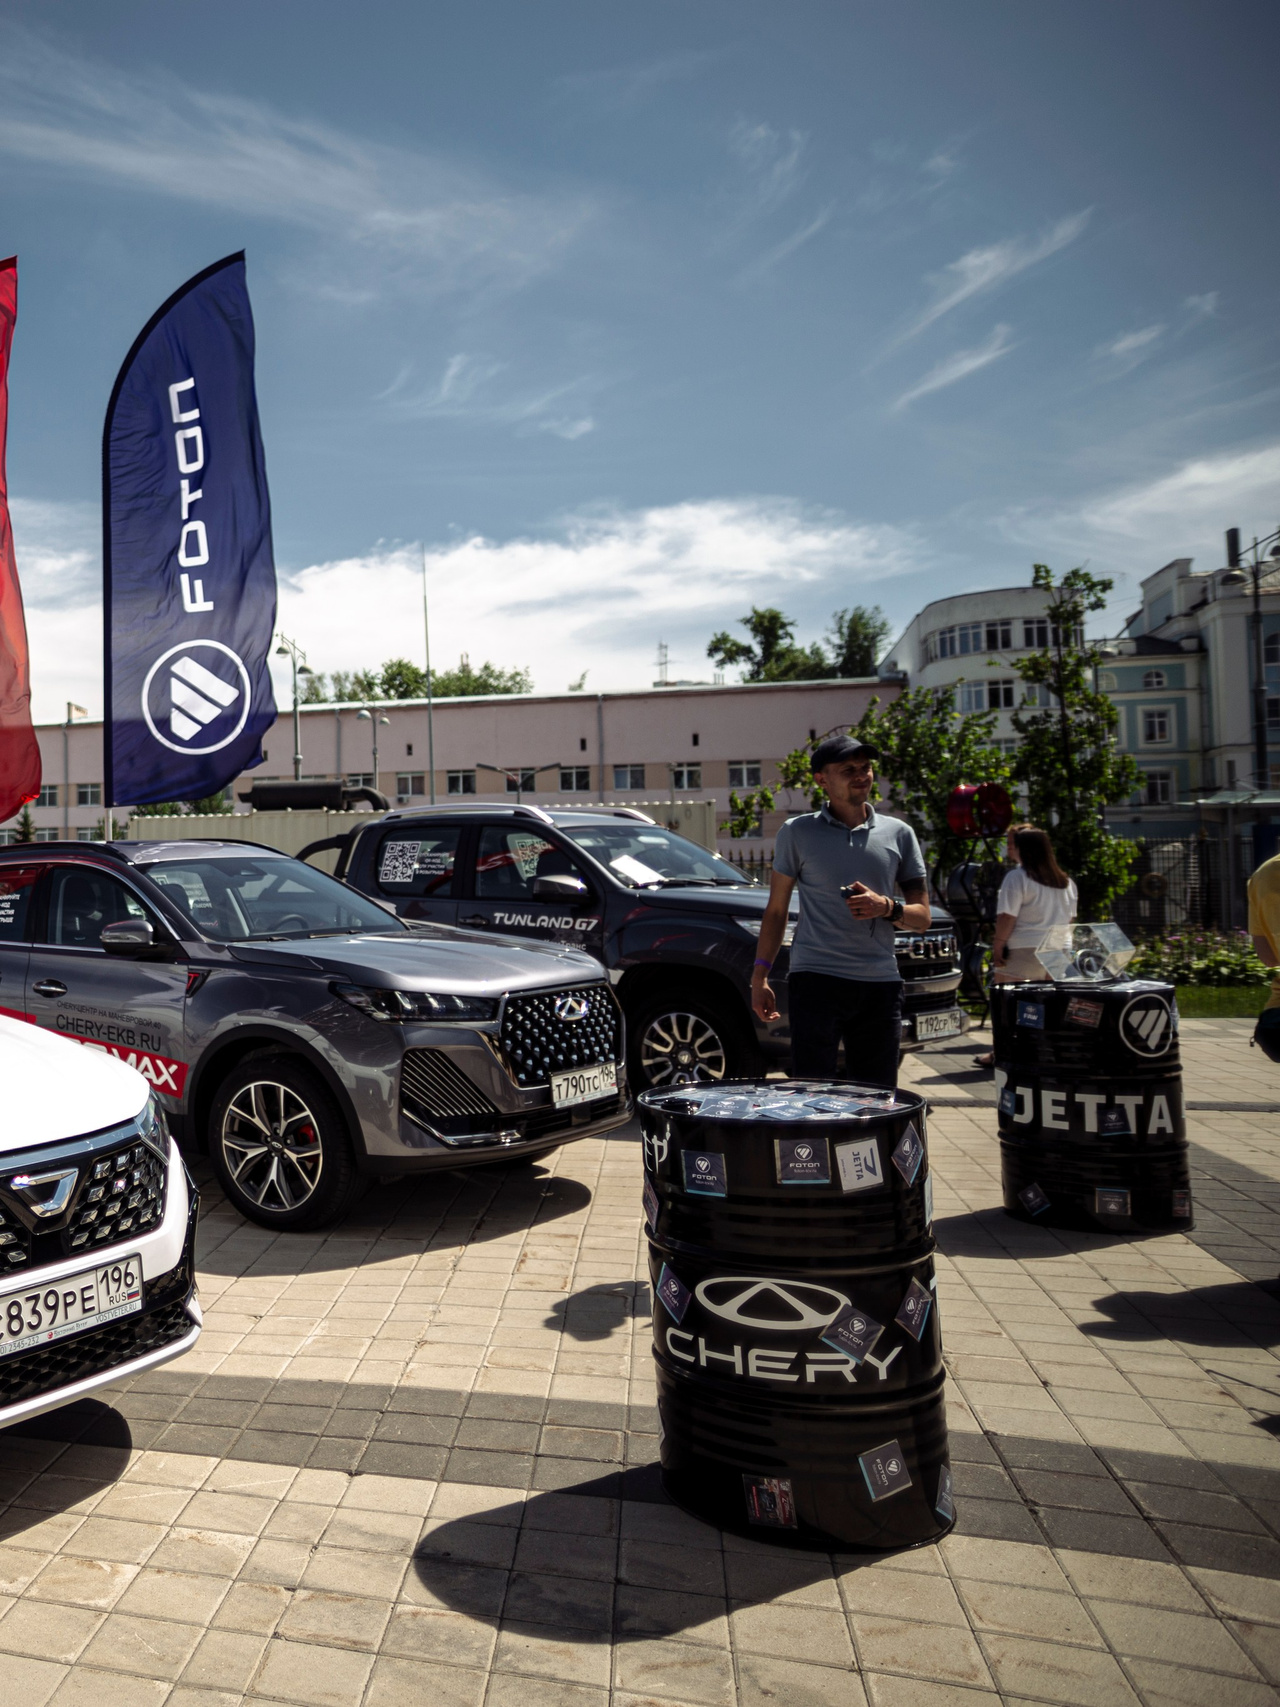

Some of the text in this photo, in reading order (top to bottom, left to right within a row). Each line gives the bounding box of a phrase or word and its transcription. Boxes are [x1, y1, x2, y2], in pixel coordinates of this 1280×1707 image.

[168, 376, 214, 614] FOTON
[493, 912, 599, 931] TUNLAND G7
[98, 1009, 108, 1017] НА
[56, 1014, 162, 1052] CHERY-EKB.RU
[555, 1074, 600, 1100] Т790ТС
[1013, 1086, 1175, 1135] JETTA
[691, 1173, 718, 1181] FOTON
[851, 1151, 865, 1181] JETTA
[99, 1262, 136, 1297] 196
[95, 1302, 138, 1324] VOSTVETER.RU
[109, 1294, 127, 1306] RUS
[8, 1336, 40, 1353] 2345-232
[837, 1328, 864, 1346] FOTON
[665, 1326, 904, 1383] CHERY
[875, 1458, 889, 1486] FOTON
